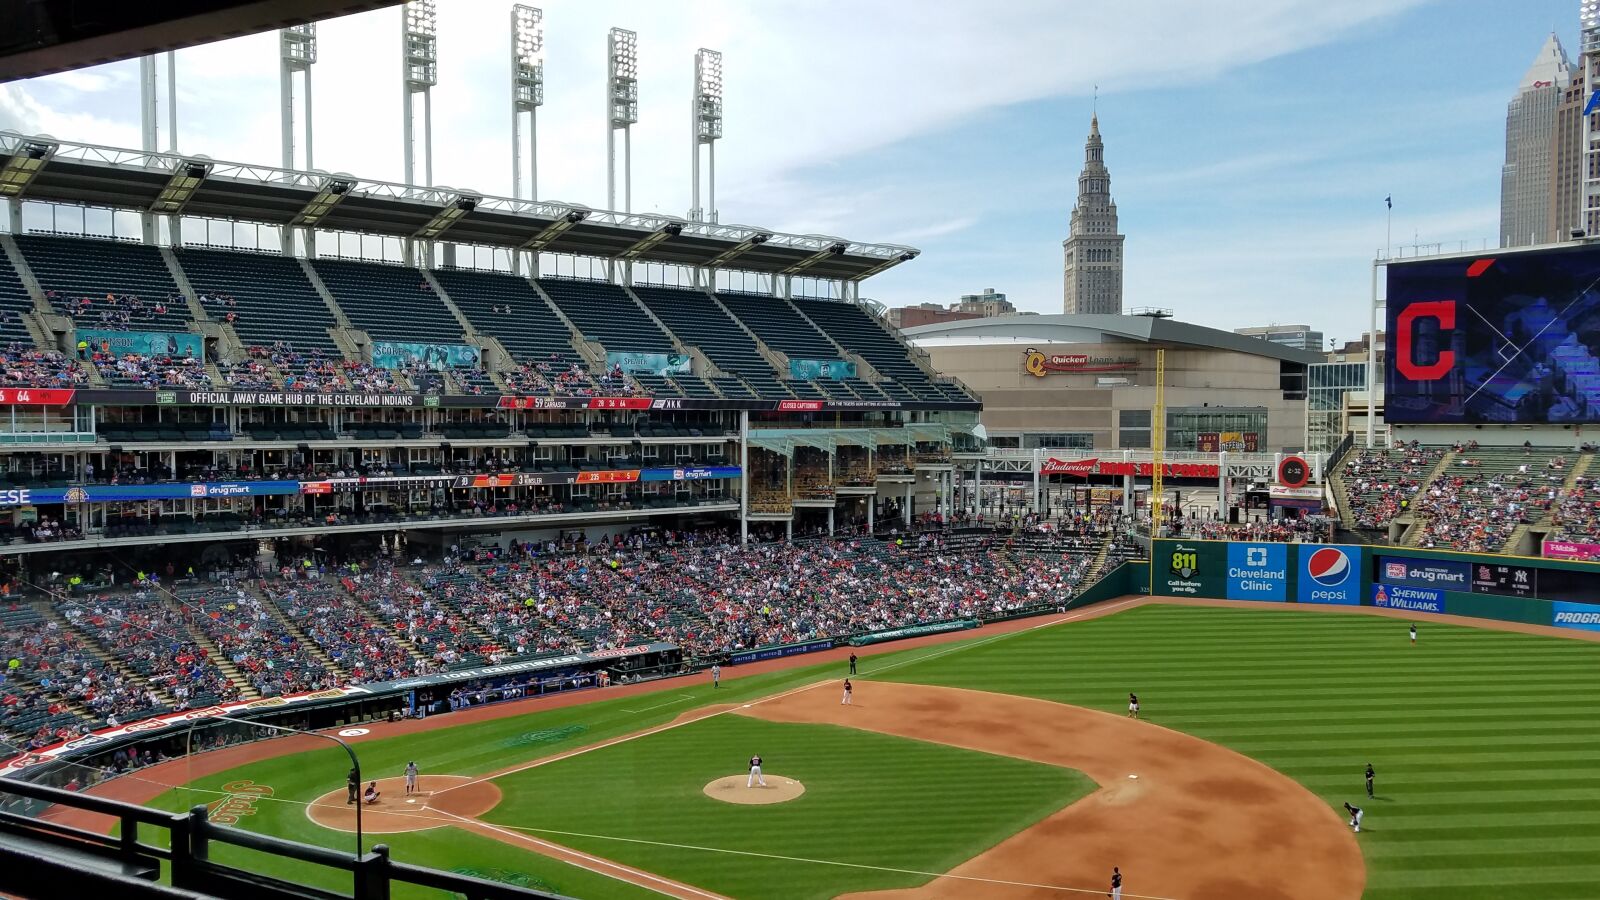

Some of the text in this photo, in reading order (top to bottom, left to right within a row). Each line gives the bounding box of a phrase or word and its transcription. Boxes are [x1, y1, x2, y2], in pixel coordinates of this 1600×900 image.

[1052, 355, 1087, 364] Quicken
[17, 390, 30, 402] 64
[190, 392, 230, 404] OFFICIAL
[232, 392, 257, 404] AWAY
[258, 393, 283, 404] GAME
[285, 393, 302, 405] HUB
[305, 394, 316, 405] OF
[317, 394, 333, 405] THE
[334, 394, 380, 406] CLEVELAND
[382, 395, 413, 406] INDIANS
[535, 397, 544, 408] 59
[1045, 461, 1092, 471] Budweiser
[1171, 463, 1219, 478] PORCH
[518, 475, 523, 485] 3
[209, 486, 229, 495] drug
[229, 486, 250, 494] mart
[1549, 543, 1578, 552] T-Mobile
[1172, 552, 1197, 570] 811
[1229, 567, 1285, 579] Cleveland
[1409, 568, 1464, 582] drug mart
[1180, 580, 1202, 588] before
[1240, 580, 1273, 591] Clinic
[1311, 590, 1346, 601] pepsi
[1391, 587, 1438, 600] SHERWIN
